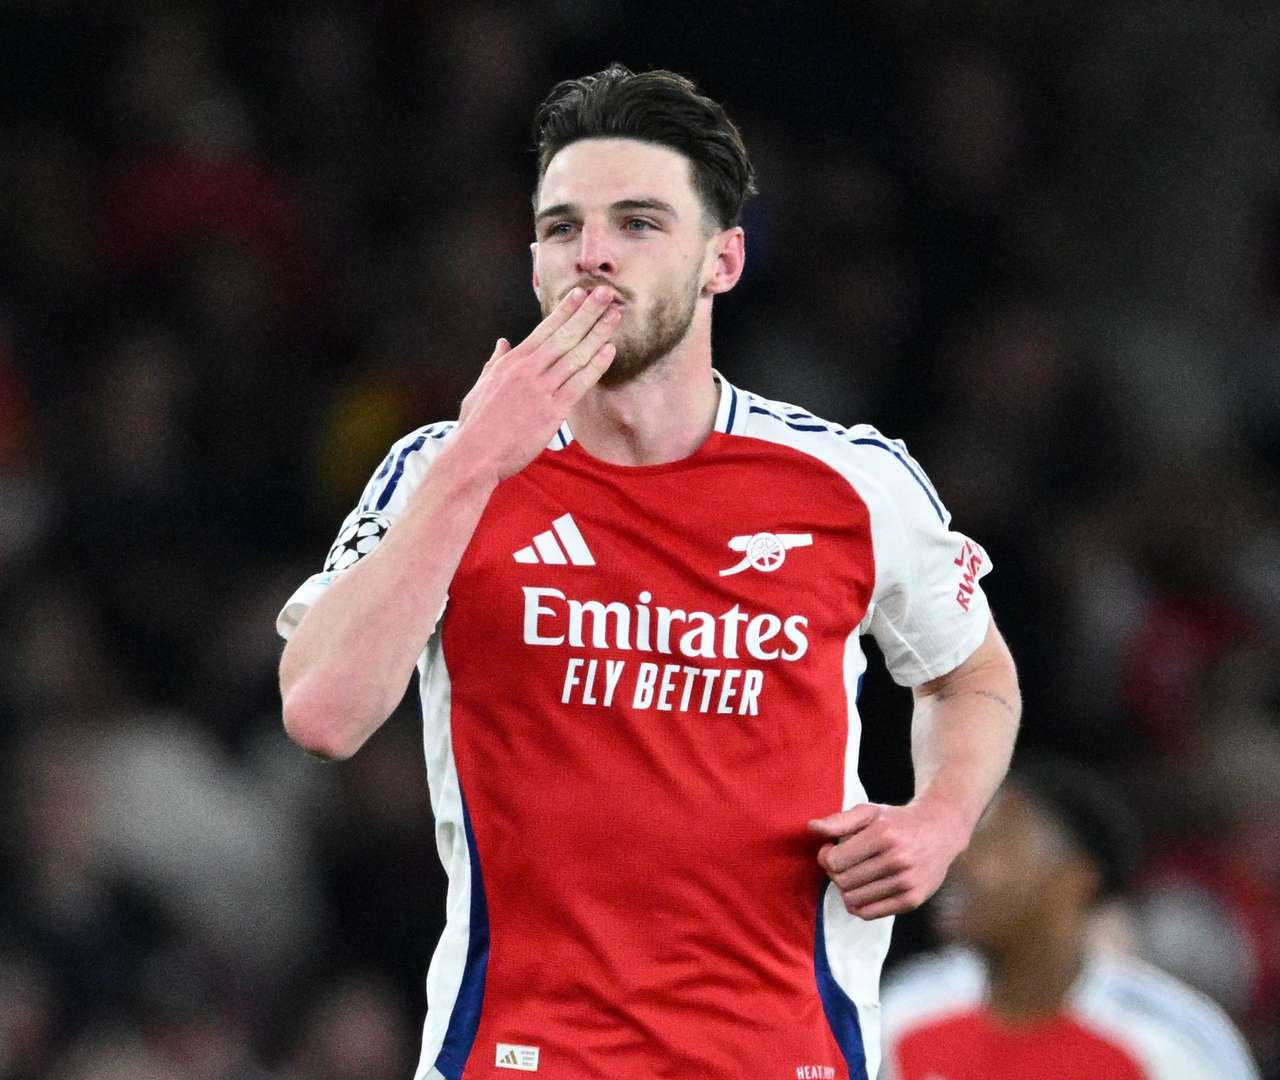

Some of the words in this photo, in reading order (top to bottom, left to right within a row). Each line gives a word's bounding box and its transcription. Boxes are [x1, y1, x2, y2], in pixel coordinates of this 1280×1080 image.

[956, 547, 982, 612] RWA
[522, 586, 809, 662] Emirates
[561, 658, 625, 707] FLY
[632, 662, 764, 716] BETTER
